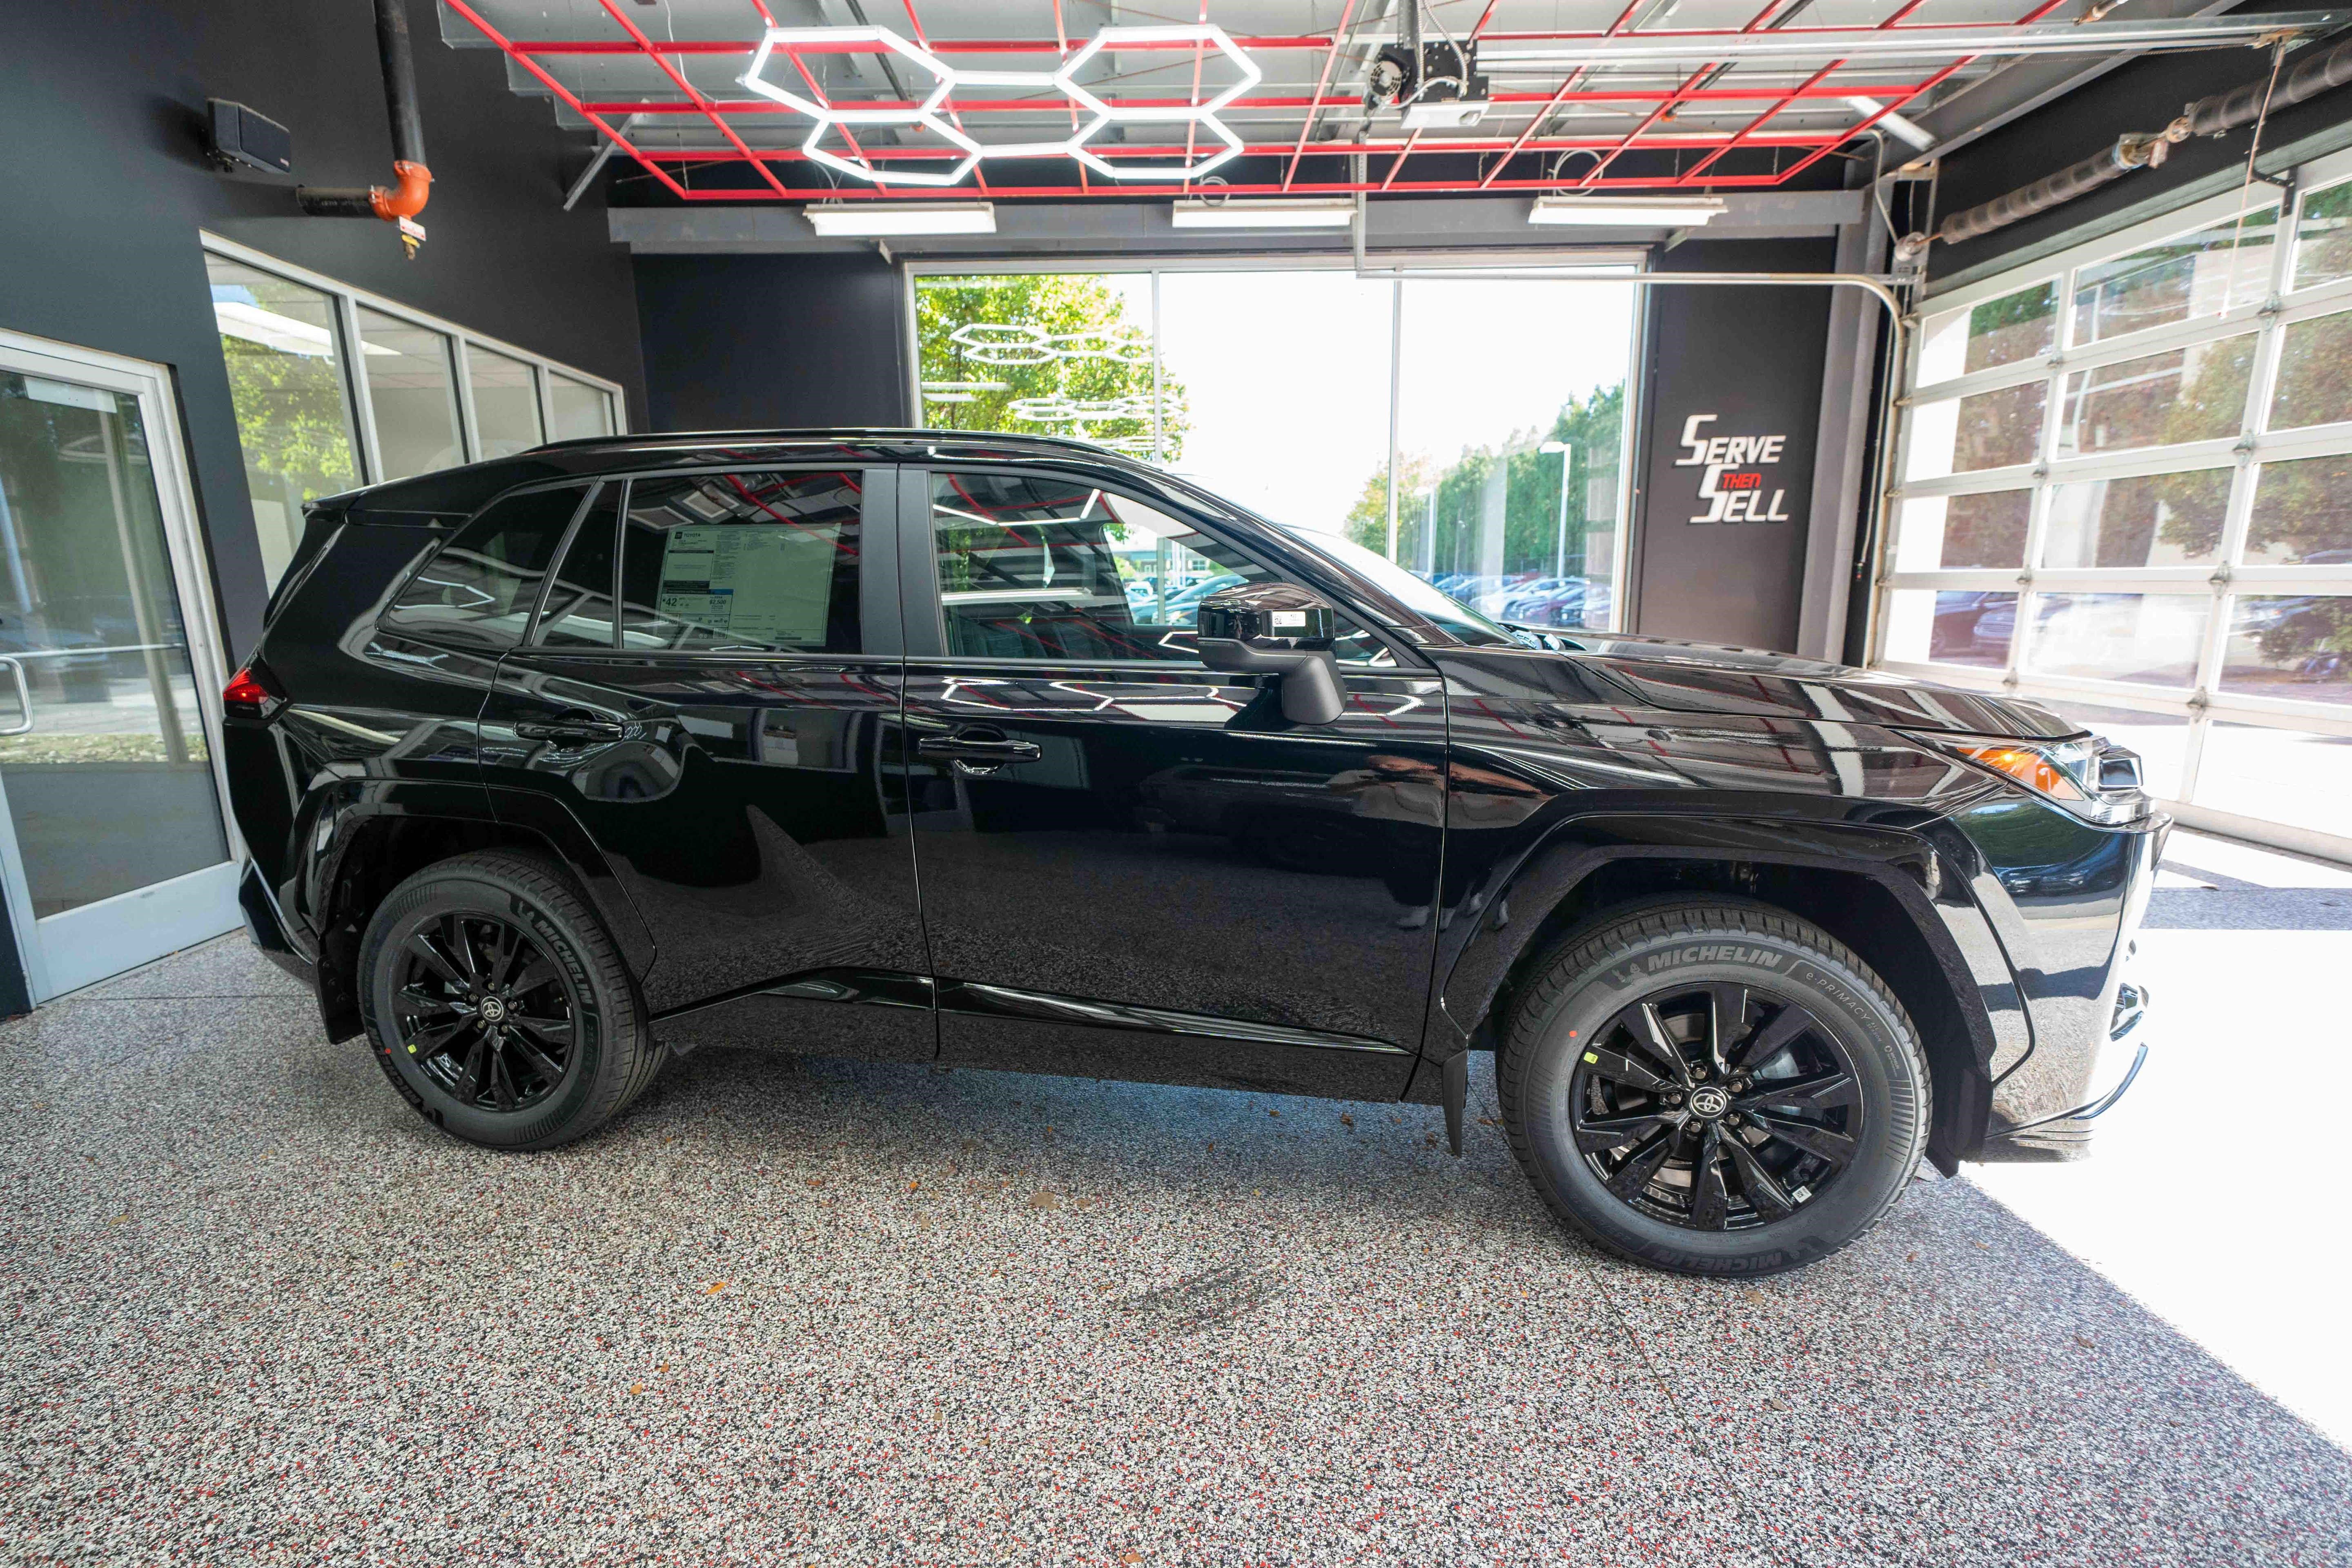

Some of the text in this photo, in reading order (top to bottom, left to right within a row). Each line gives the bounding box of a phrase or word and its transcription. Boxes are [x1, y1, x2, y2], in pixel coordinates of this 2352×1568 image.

[1675, 414, 1786, 466] SERVE
[1689, 463, 1789, 523] SELL
[1722, 473, 1762, 489] THEN
[666, 597, 677, 607] 42
[534, 920, 593, 1004] MICHELIN
[1648, 946, 1783, 971] MICHELIN
[1651, 1250, 1784, 1272] MICHELIN
